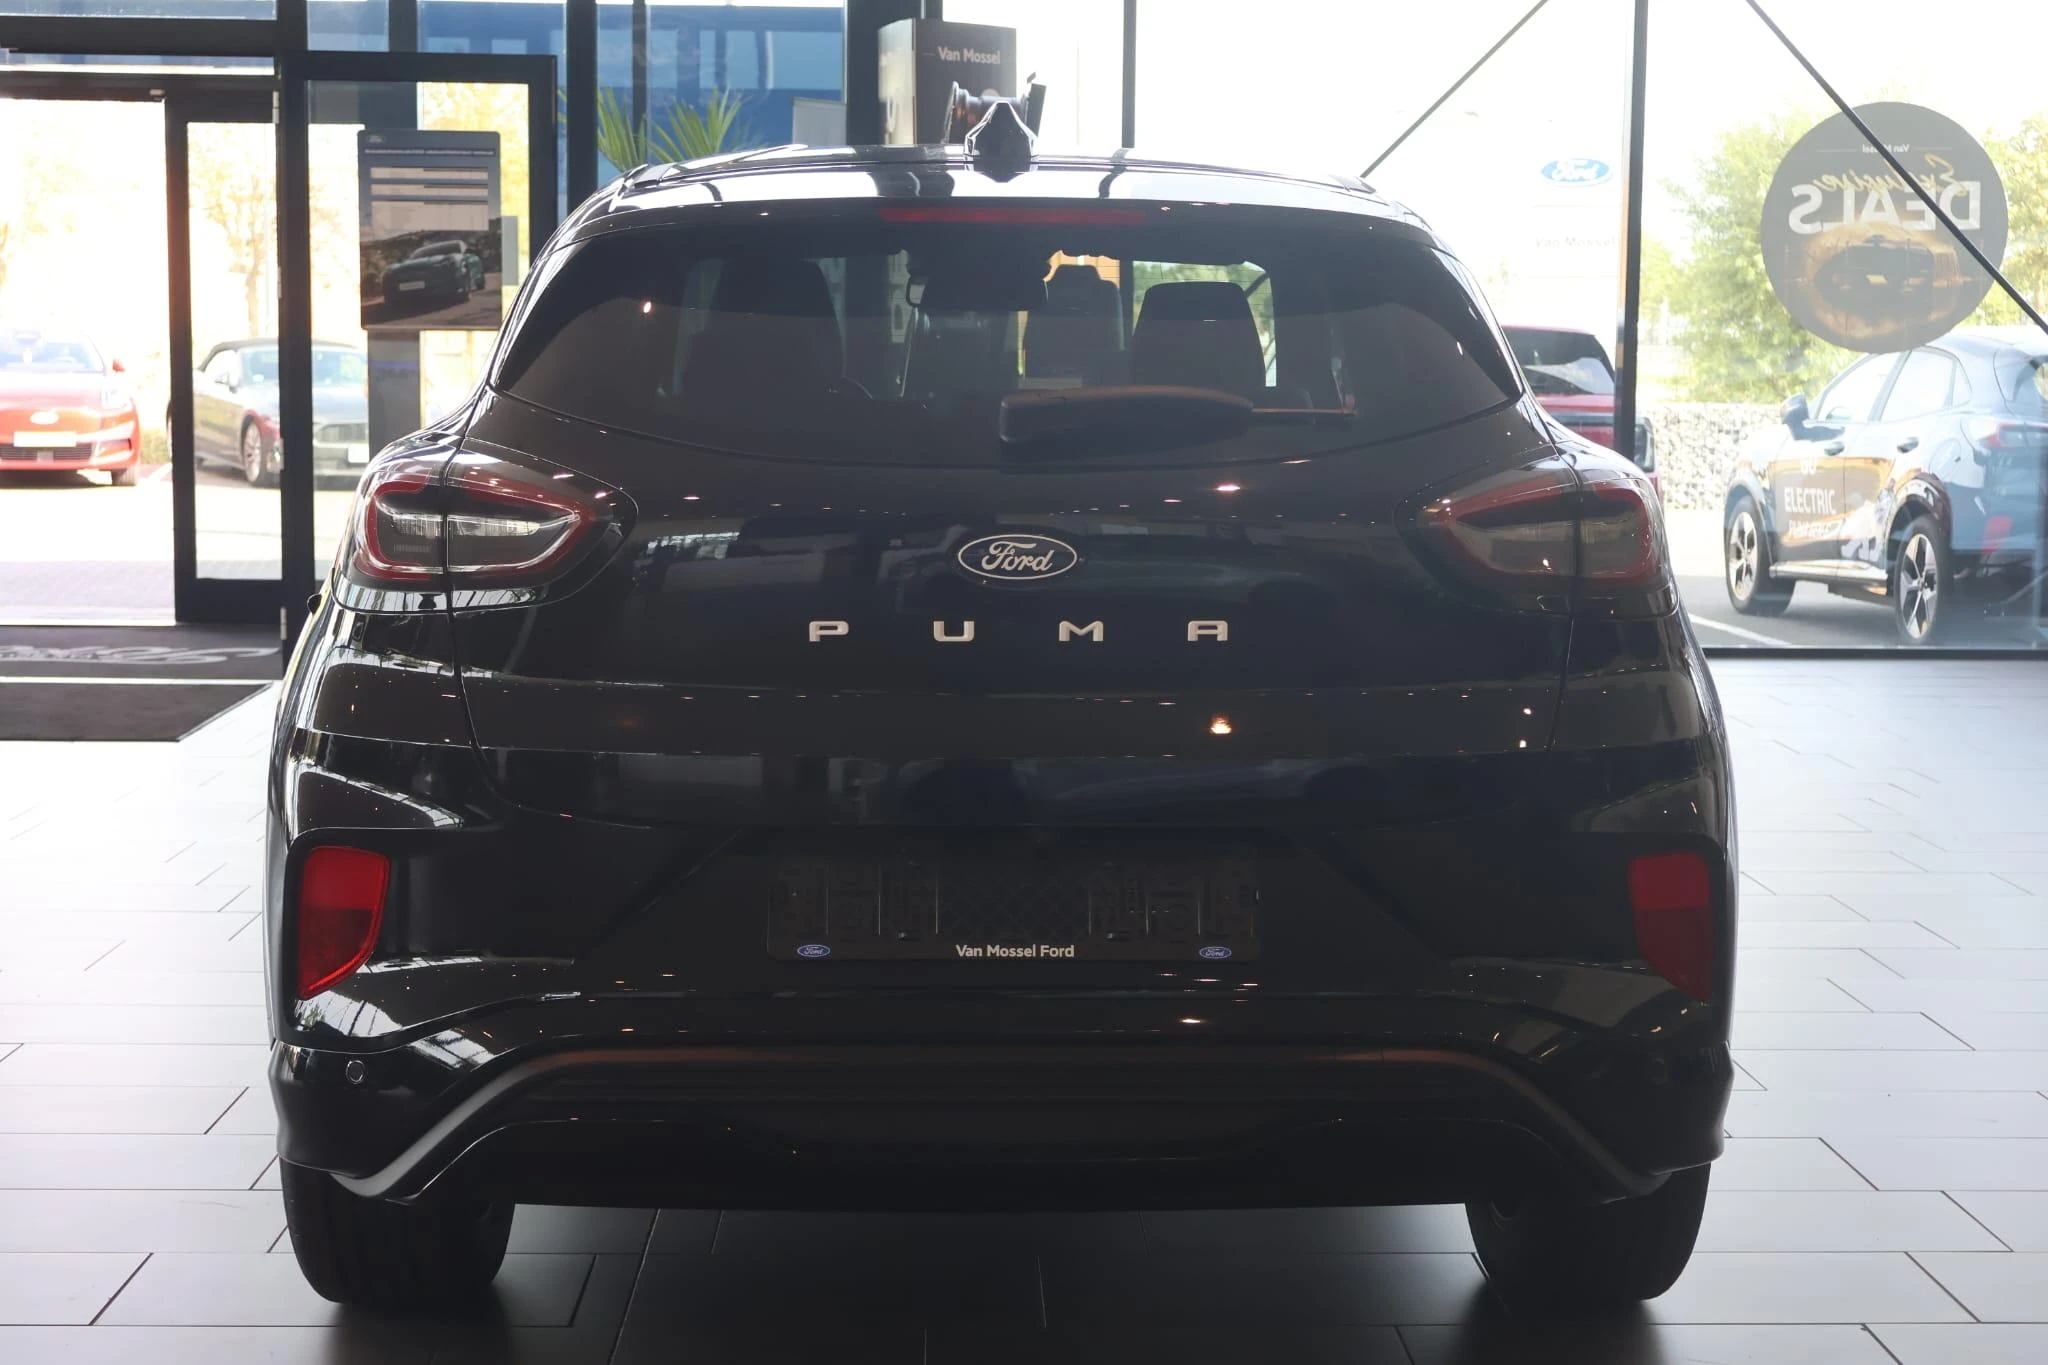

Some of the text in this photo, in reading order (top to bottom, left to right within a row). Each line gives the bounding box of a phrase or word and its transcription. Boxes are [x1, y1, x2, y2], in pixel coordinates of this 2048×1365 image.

[937, 46, 1001, 64] Van Mossel
[1784, 487, 1836, 514] ELECTRIC
[981, 541, 1054, 571] Ford
[809, 620, 1228, 642] PUMA
[956, 944, 1074, 957] Van Mossel Ford
